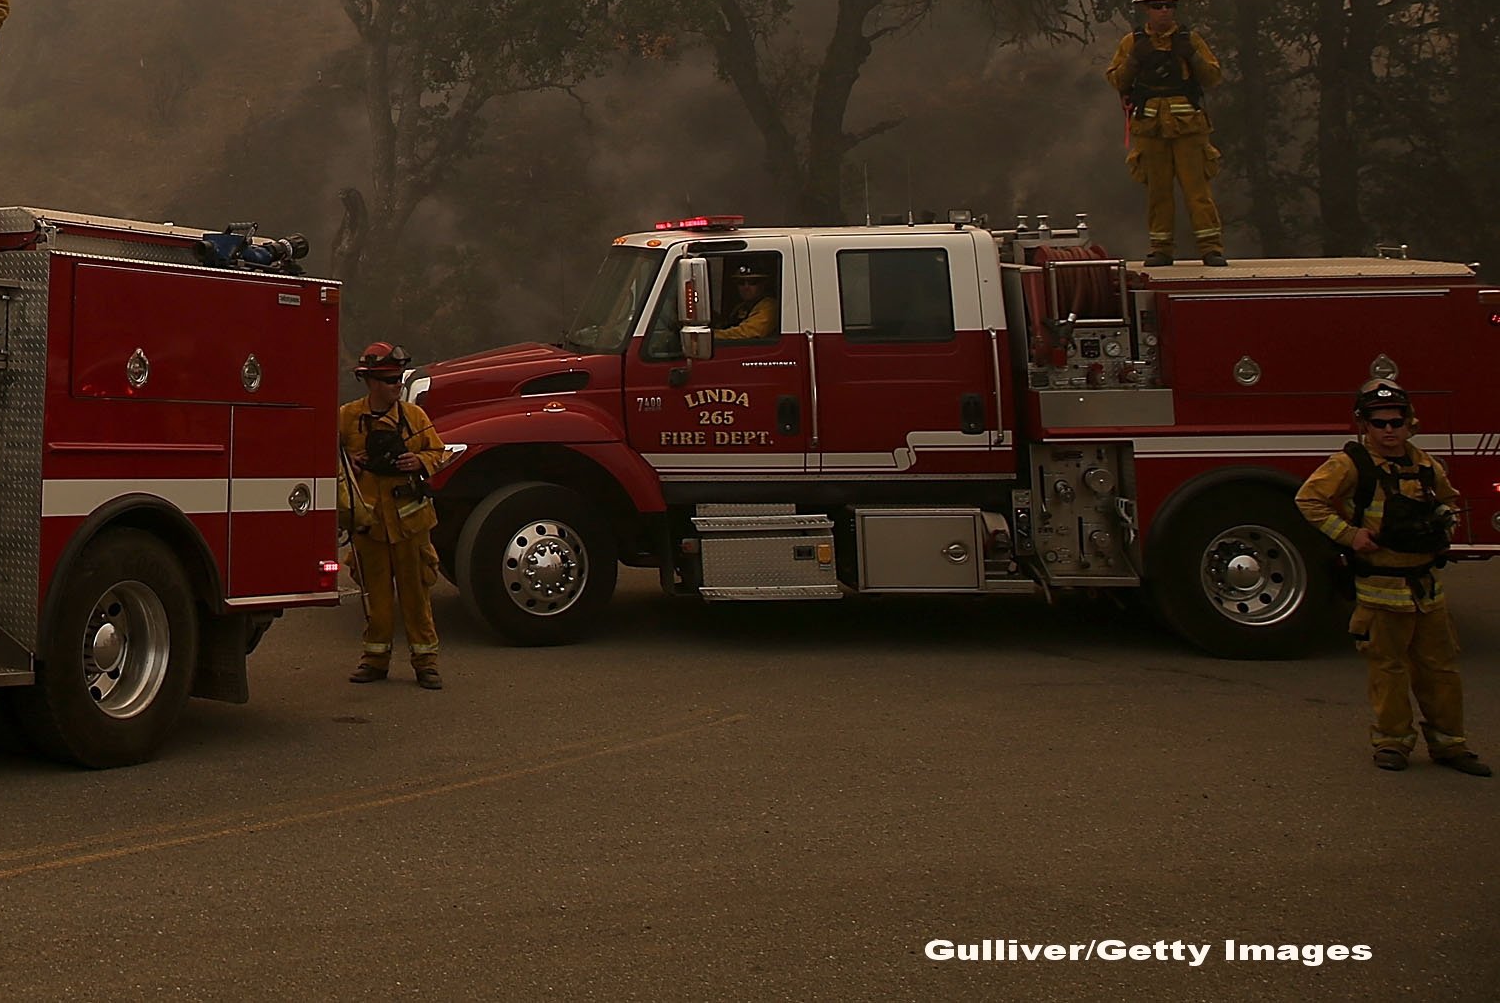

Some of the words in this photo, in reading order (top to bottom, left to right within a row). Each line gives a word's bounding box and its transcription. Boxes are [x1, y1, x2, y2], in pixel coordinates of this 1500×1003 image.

[684, 388, 749, 408] LINDA
[699, 410, 735, 425] 265
[660, 431, 706, 445] FIRE
[715, 431, 775, 445] DEPT.
